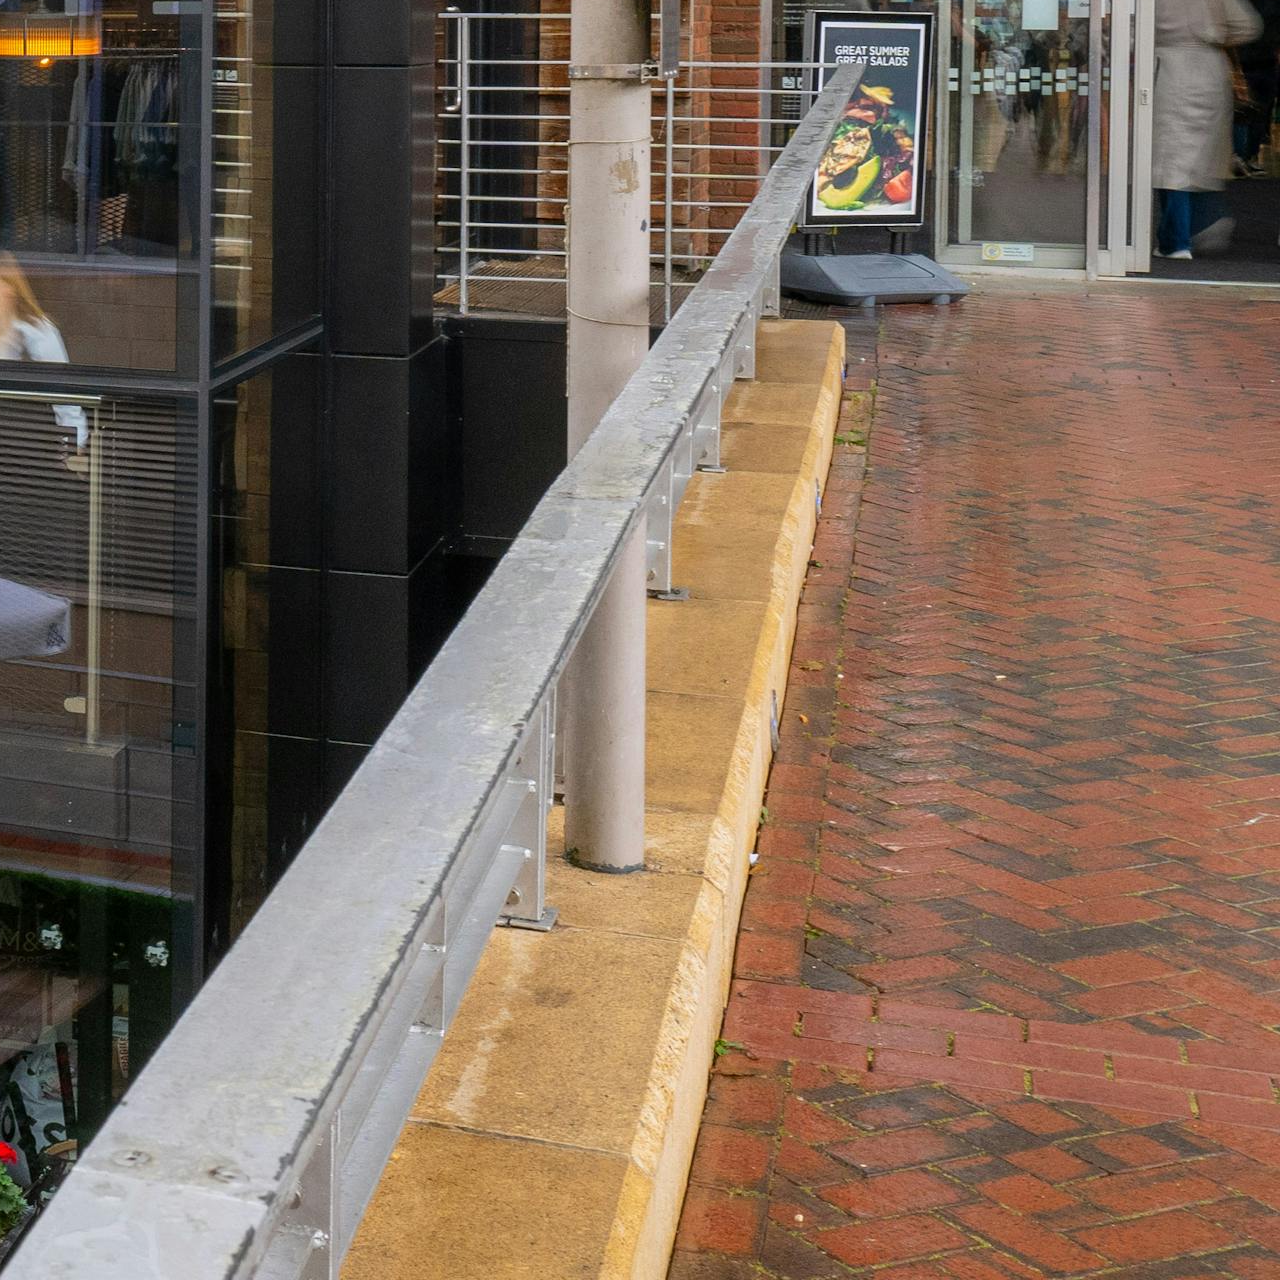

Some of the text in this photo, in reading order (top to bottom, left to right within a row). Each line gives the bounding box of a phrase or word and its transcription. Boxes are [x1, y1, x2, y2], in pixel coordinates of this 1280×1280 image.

[835, 45, 910, 57] GREAT SUMMER
[836, 56, 908, 67] GREAT SALADS
